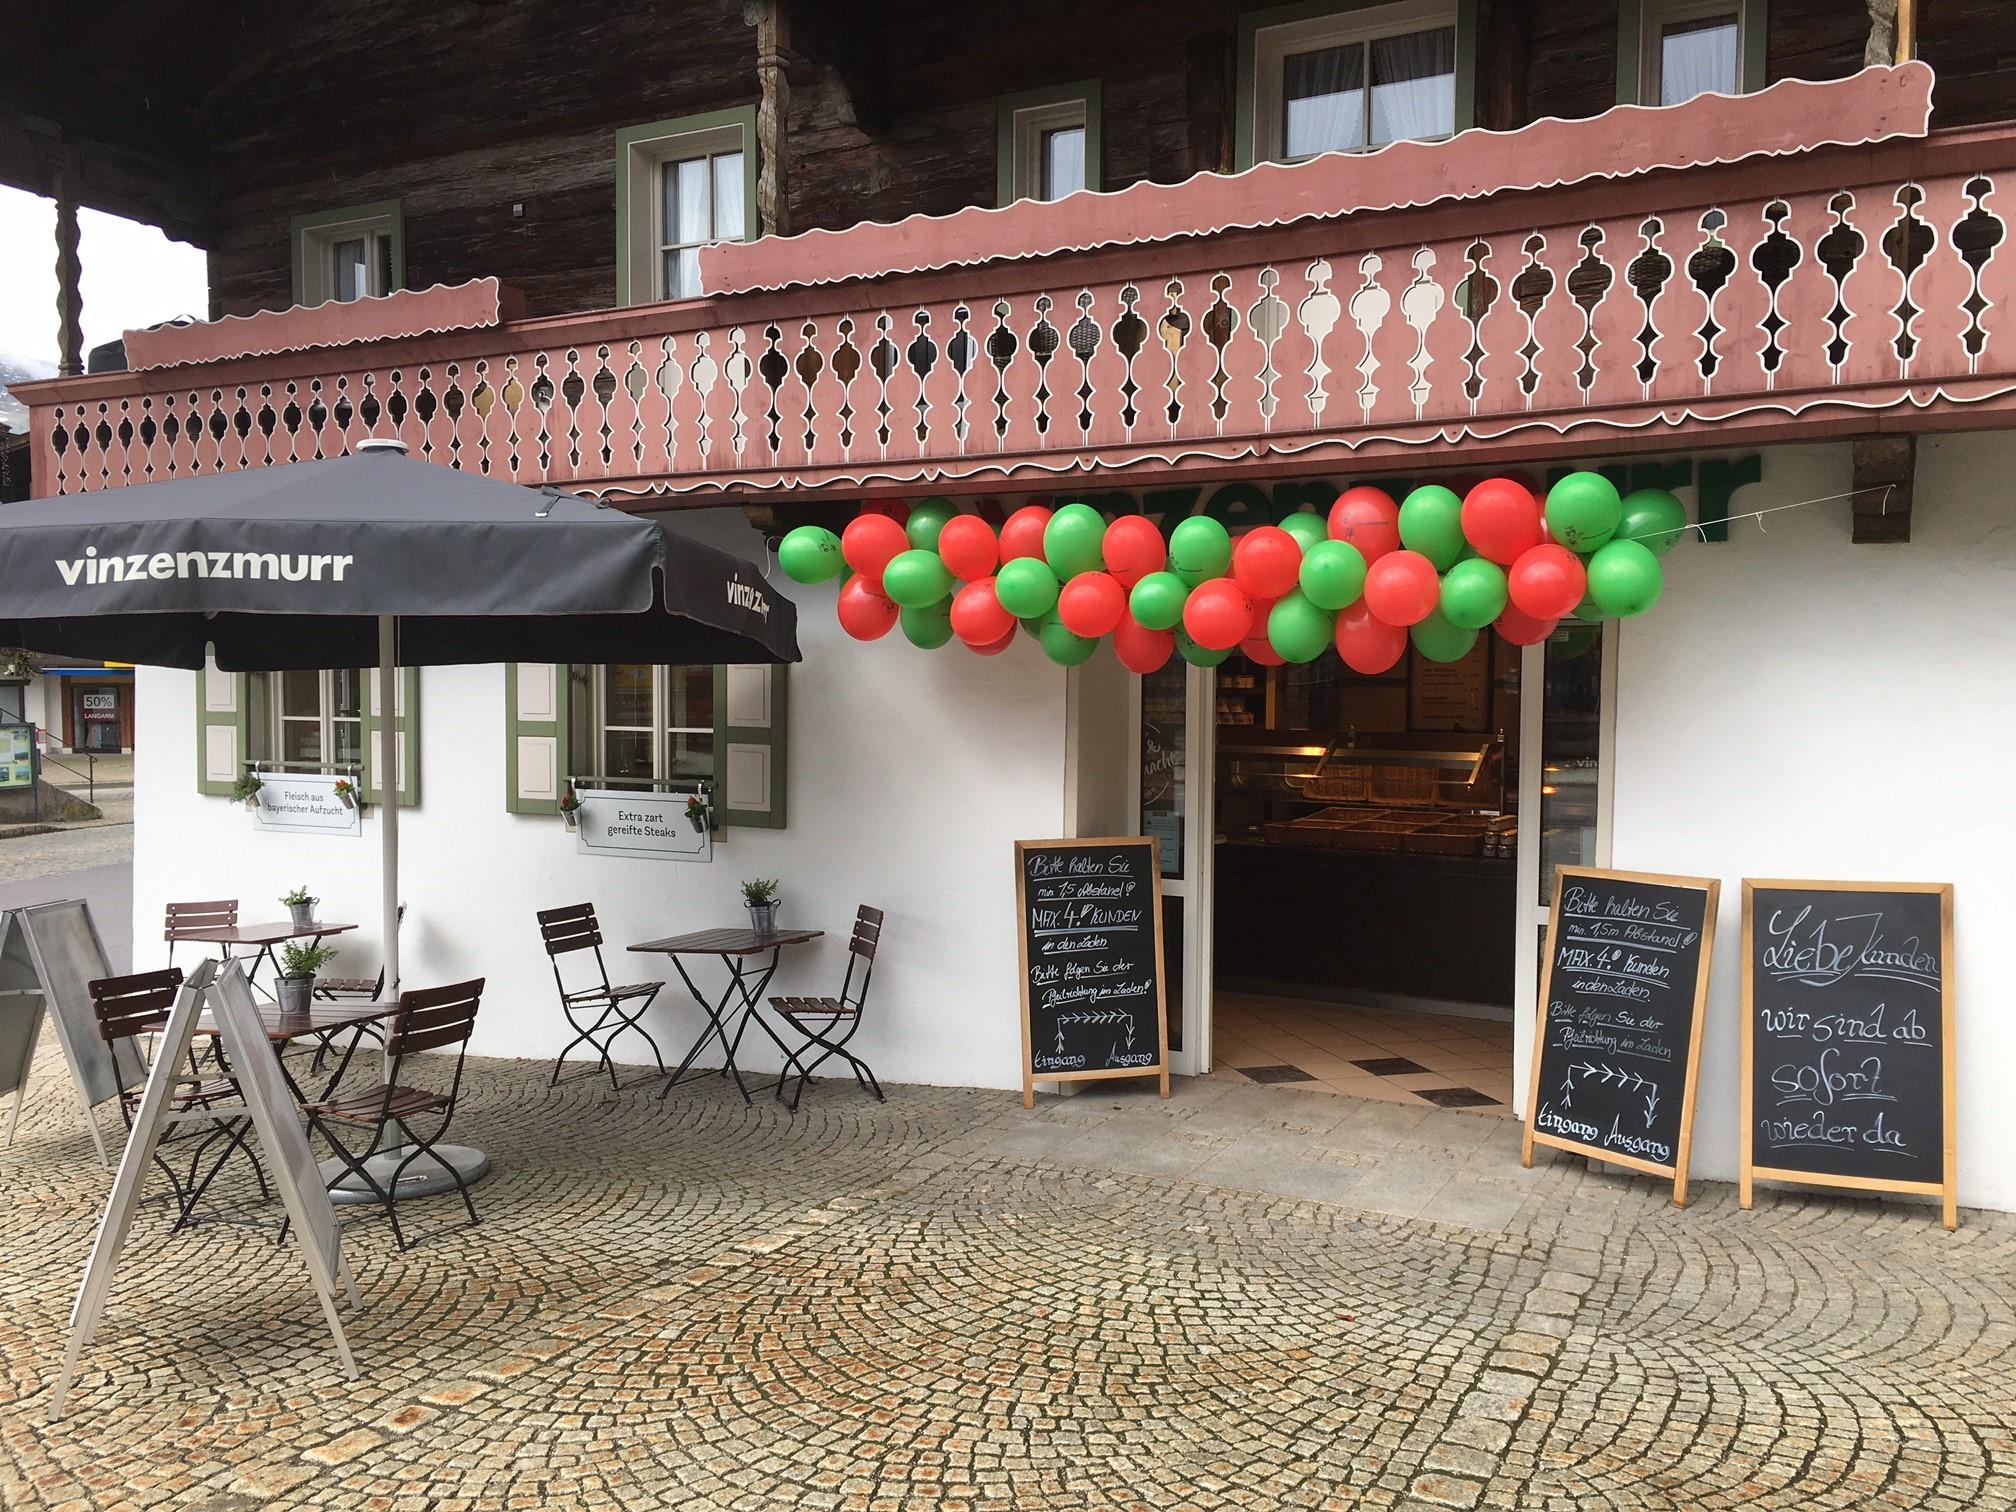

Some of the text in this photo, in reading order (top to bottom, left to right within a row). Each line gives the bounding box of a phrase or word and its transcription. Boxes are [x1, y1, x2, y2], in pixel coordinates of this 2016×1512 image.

[55, 546, 353, 585] vinzenzmurr
[86, 697, 112, 707] 50%
[285, 791, 309, 801] Fleisch
[267, 803, 343, 815] bayerischer Aufzucht
[619, 811, 663, 822] Extra zart
[608, 825, 676, 837] gereifte Steaks
[1028, 855, 1130, 876] Bitte halten Sie
[1090, 909, 1142, 925] KUNDEN
[1564, 887, 1679, 922] Bitte halten Sie
[1042, 934, 1107, 950] in den Laden
[1763, 905, 1940, 978] Liebe Kunden
[1031, 958, 1134, 983] Bitte folgen Sie der
[1623, 953, 1669, 978] Kunden
[1099, 985, 1111, 996] im
[1113, 979, 1152, 994] Laden!
[1572, 977, 1585, 988] in
[1585, 977, 1608, 992] den
[1551, 1001, 1664, 1029] Bitte folgen Sie der
[1761, 1003, 1926, 1042] wir sind ab
[1035, 1041, 1152, 1068] Eingang Ausgang
[1559, 1026, 1671, 1058] Pfeilrichtung im Laden
[1772, 1048, 1882, 1105] sofort
[1538, 1101, 1670, 1161] Eingang Ausgang
[1761, 1111, 1907, 1147] wieder da
